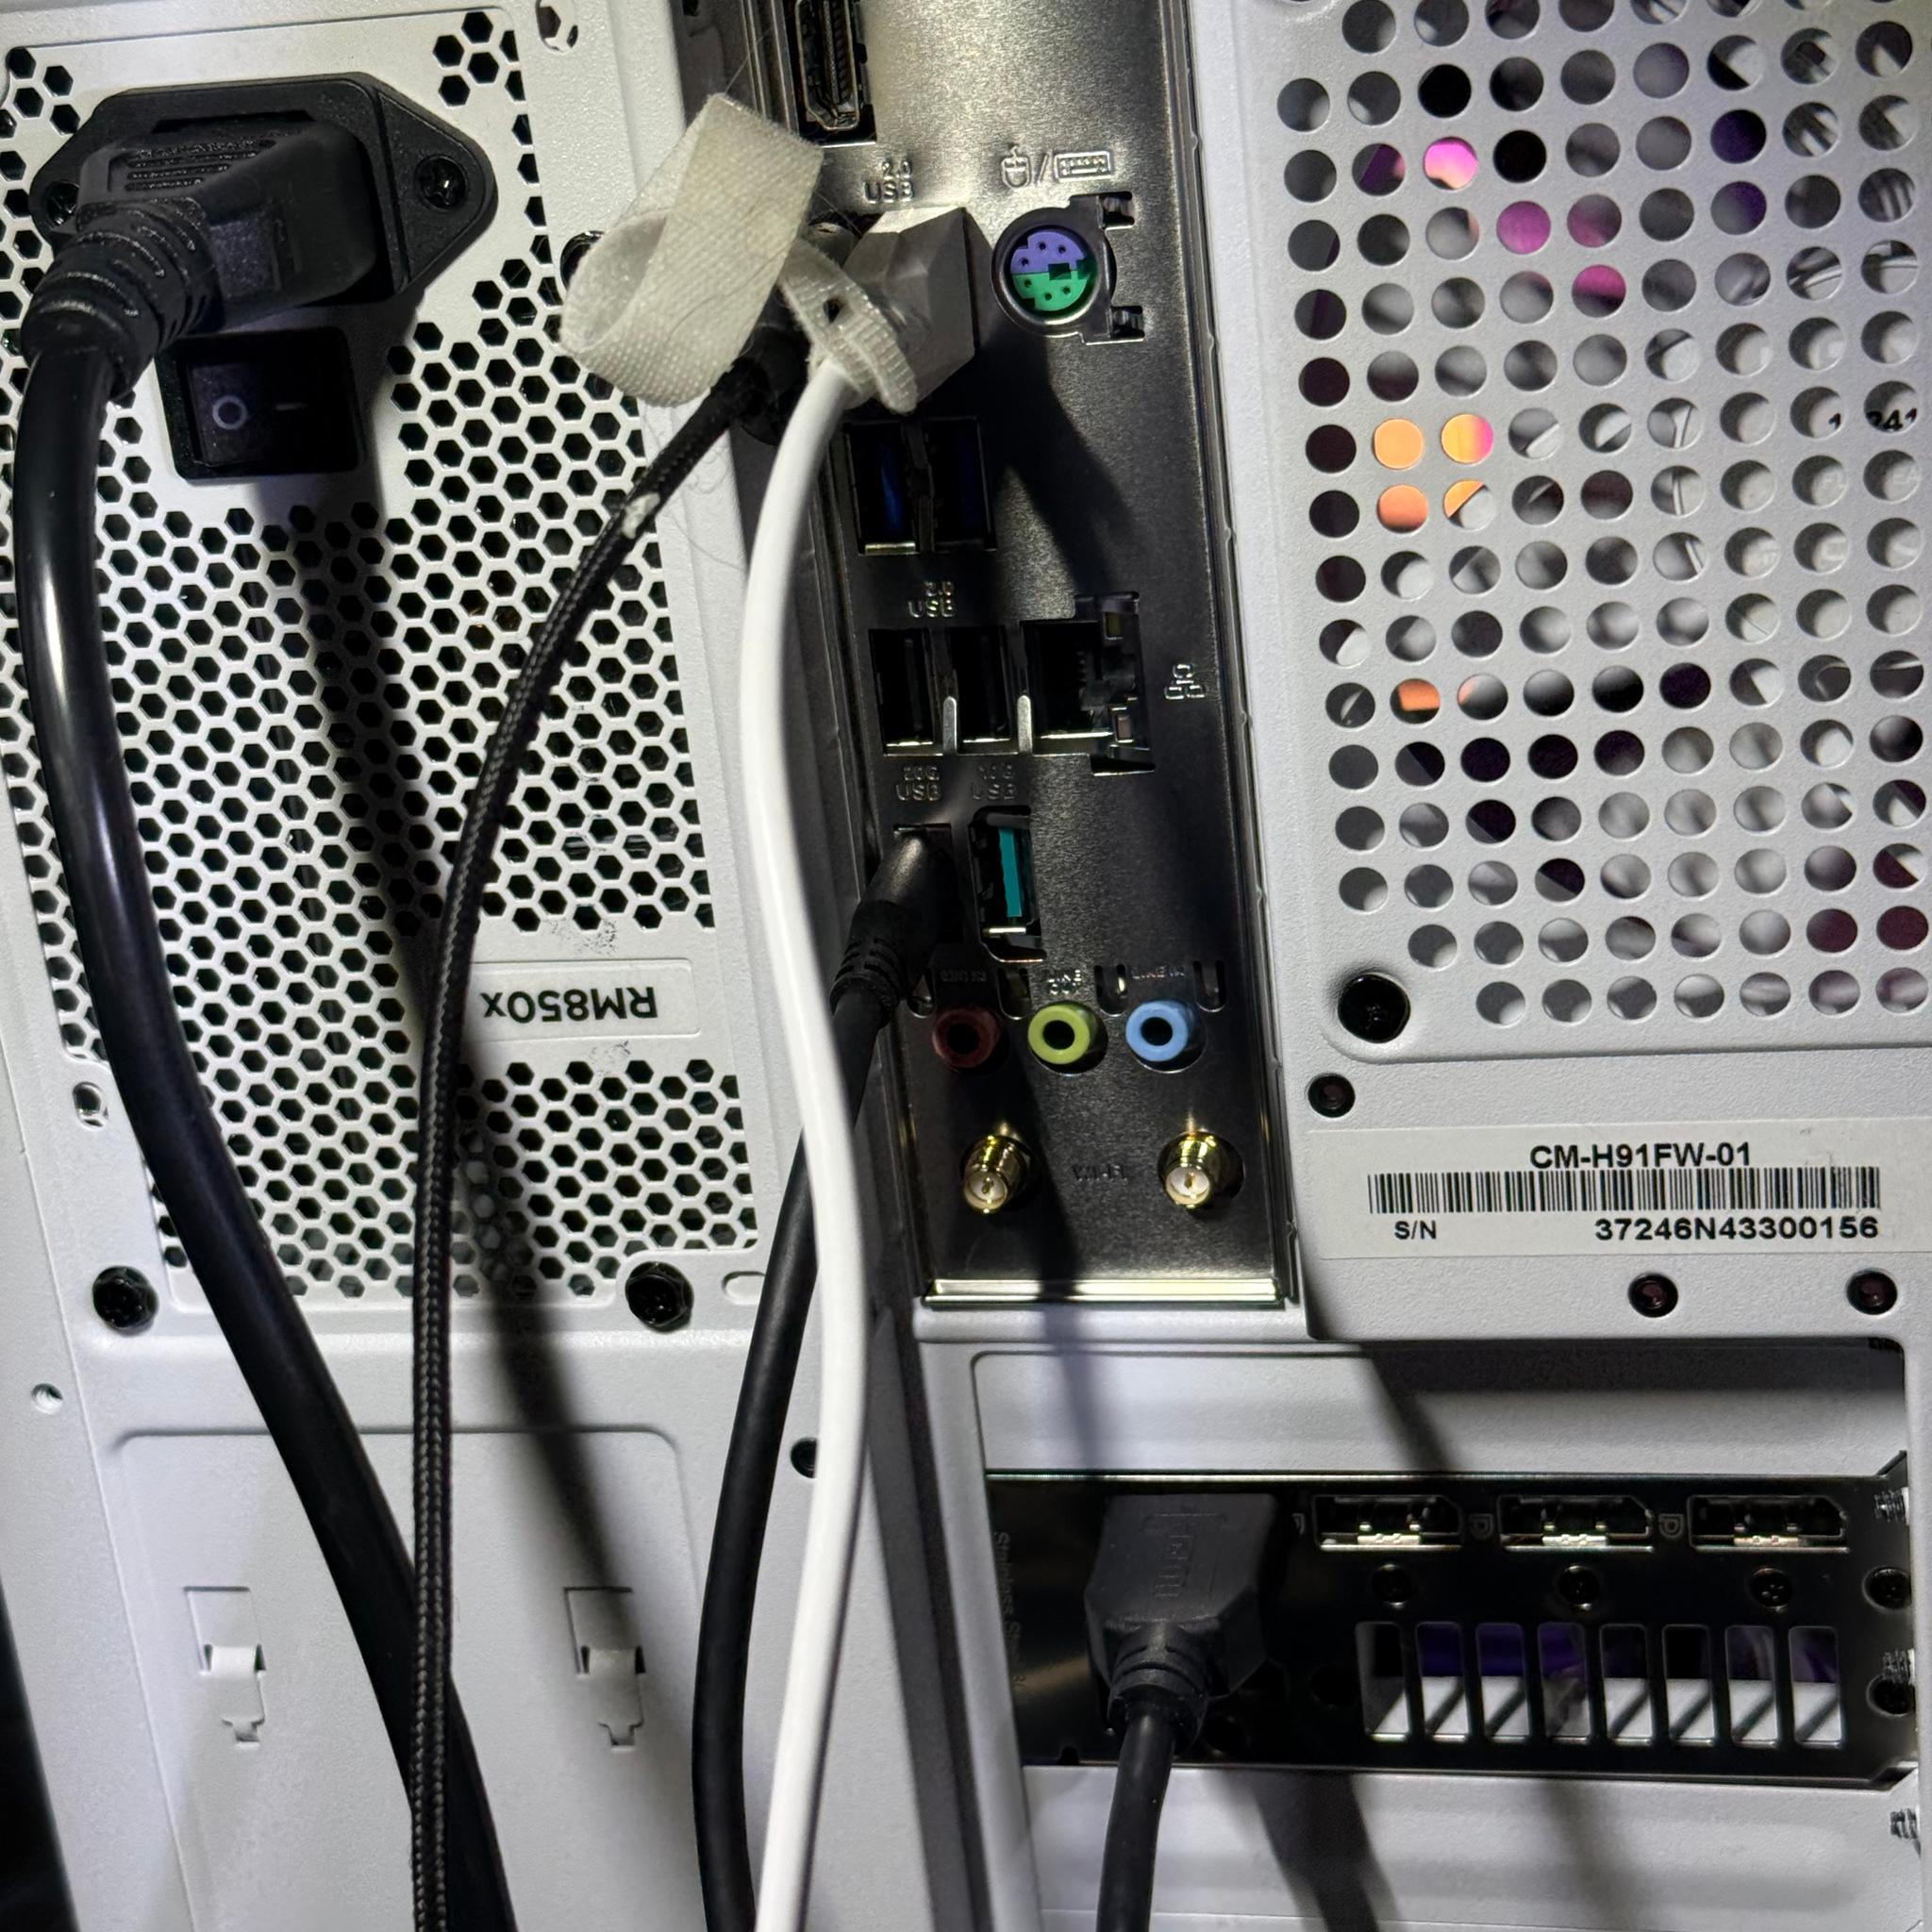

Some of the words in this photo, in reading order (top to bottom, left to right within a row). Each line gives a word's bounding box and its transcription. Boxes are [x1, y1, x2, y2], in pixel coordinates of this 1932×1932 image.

[863, 179, 915, 204] USB
[895, 782, 941, 802] USB
[479, 987, 658, 1024] RM850x
[1529, 1142, 1751, 1169] CM-H91FW-01
[1394, 1220, 1437, 1241] S/N
[1594, 1215, 1879, 1241] 37246N43300156
